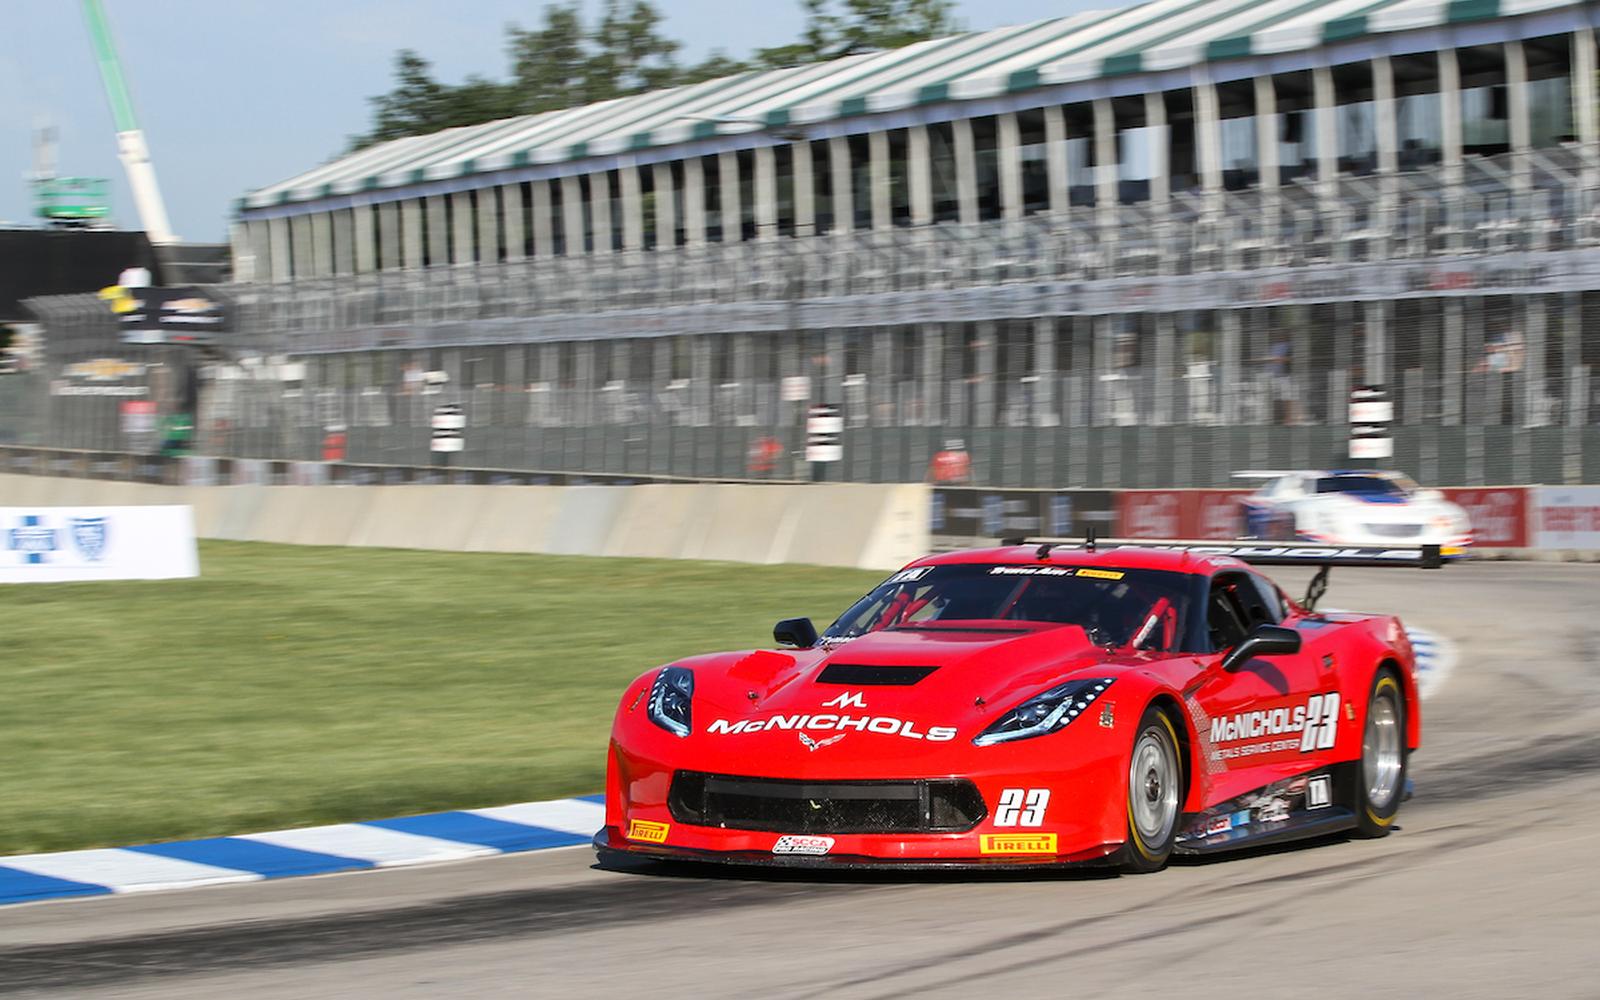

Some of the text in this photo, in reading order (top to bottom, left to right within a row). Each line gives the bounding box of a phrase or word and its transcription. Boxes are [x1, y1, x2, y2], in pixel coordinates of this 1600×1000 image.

[706, 713, 958, 742] McNICHOLS
[1210, 705, 1306, 743] McNICHOLS
[1300, 691, 1342, 753] 23
[993, 788, 1052, 828] 23
[631, 823, 665, 841] PIRELLI
[792, 838, 828, 847] SCCA
[987, 835, 1051, 851] PIRELLI
